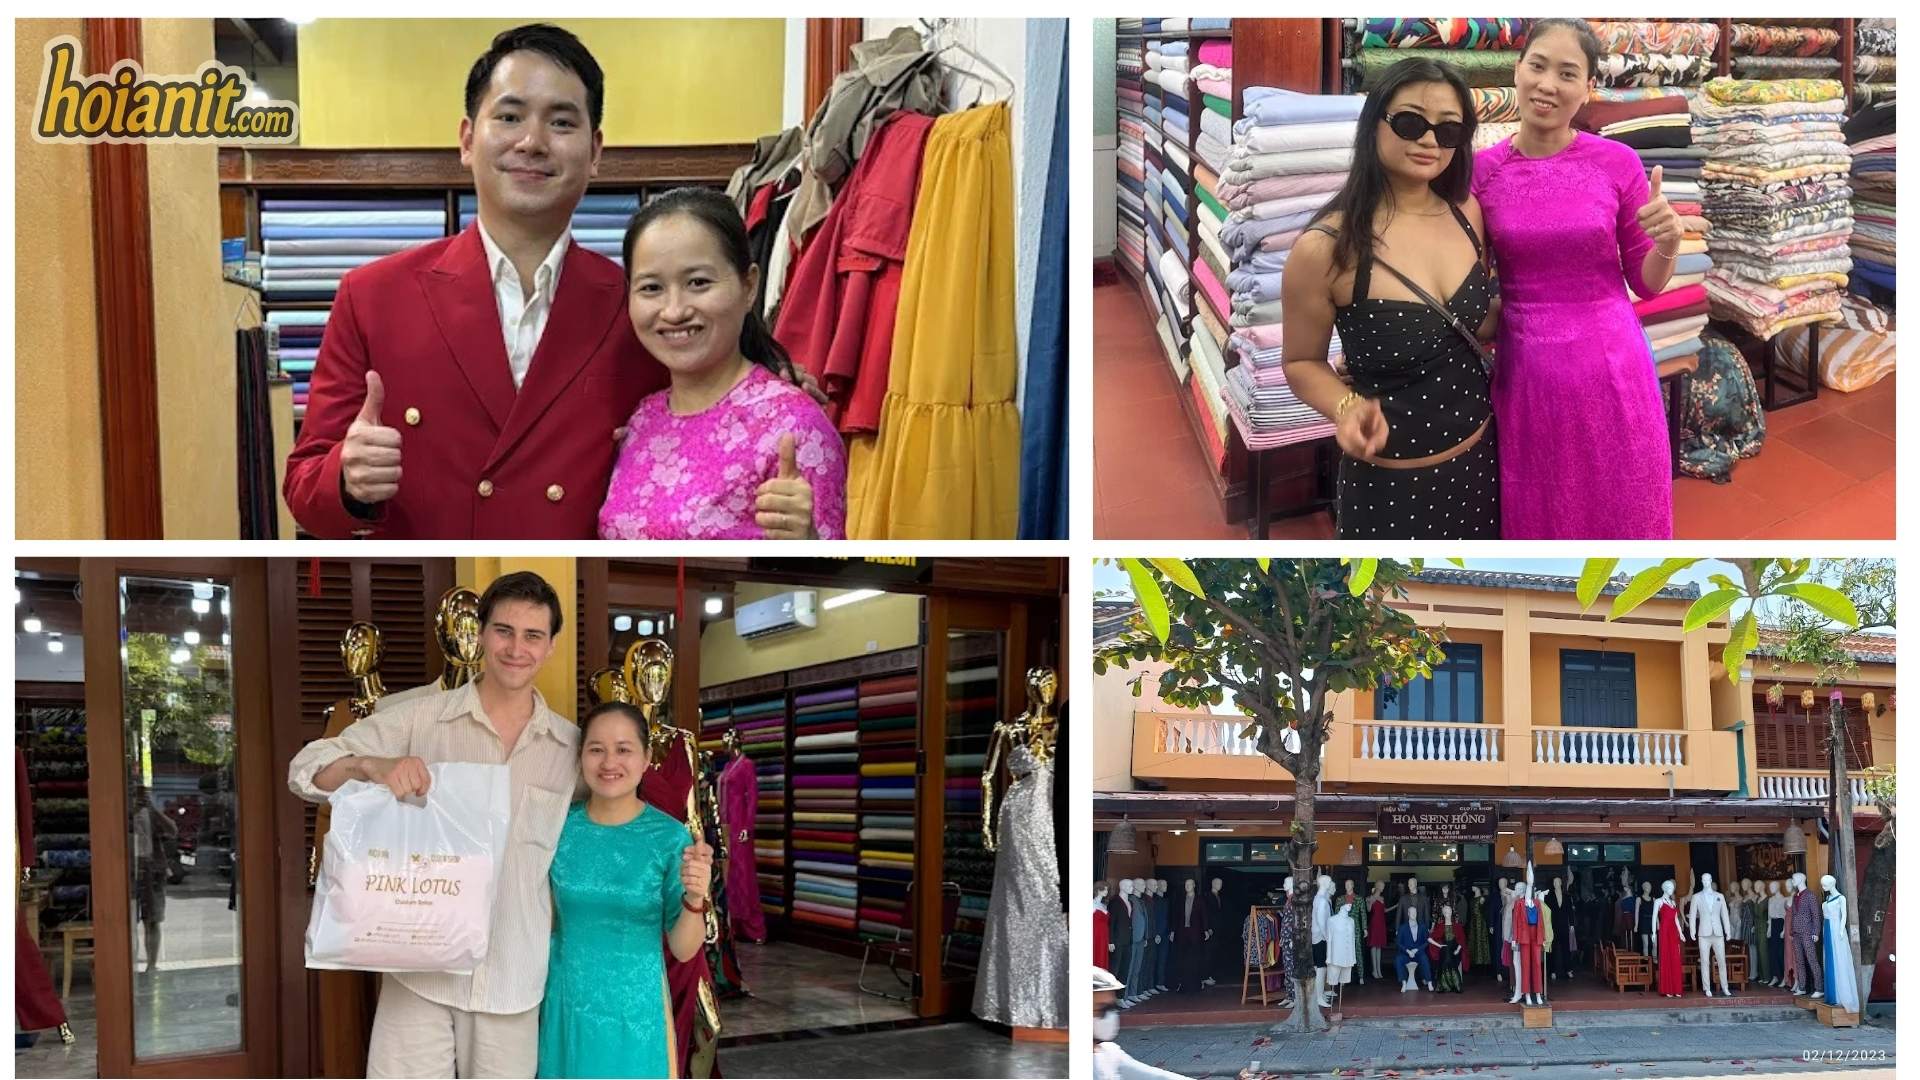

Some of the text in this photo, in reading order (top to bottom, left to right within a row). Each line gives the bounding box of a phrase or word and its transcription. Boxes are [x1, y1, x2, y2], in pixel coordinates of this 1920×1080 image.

[1392, 814, 1418, 824] HOA
[1420, 814, 1449, 824] SEN
[366, 874, 461, 897] PINK LOTUS
